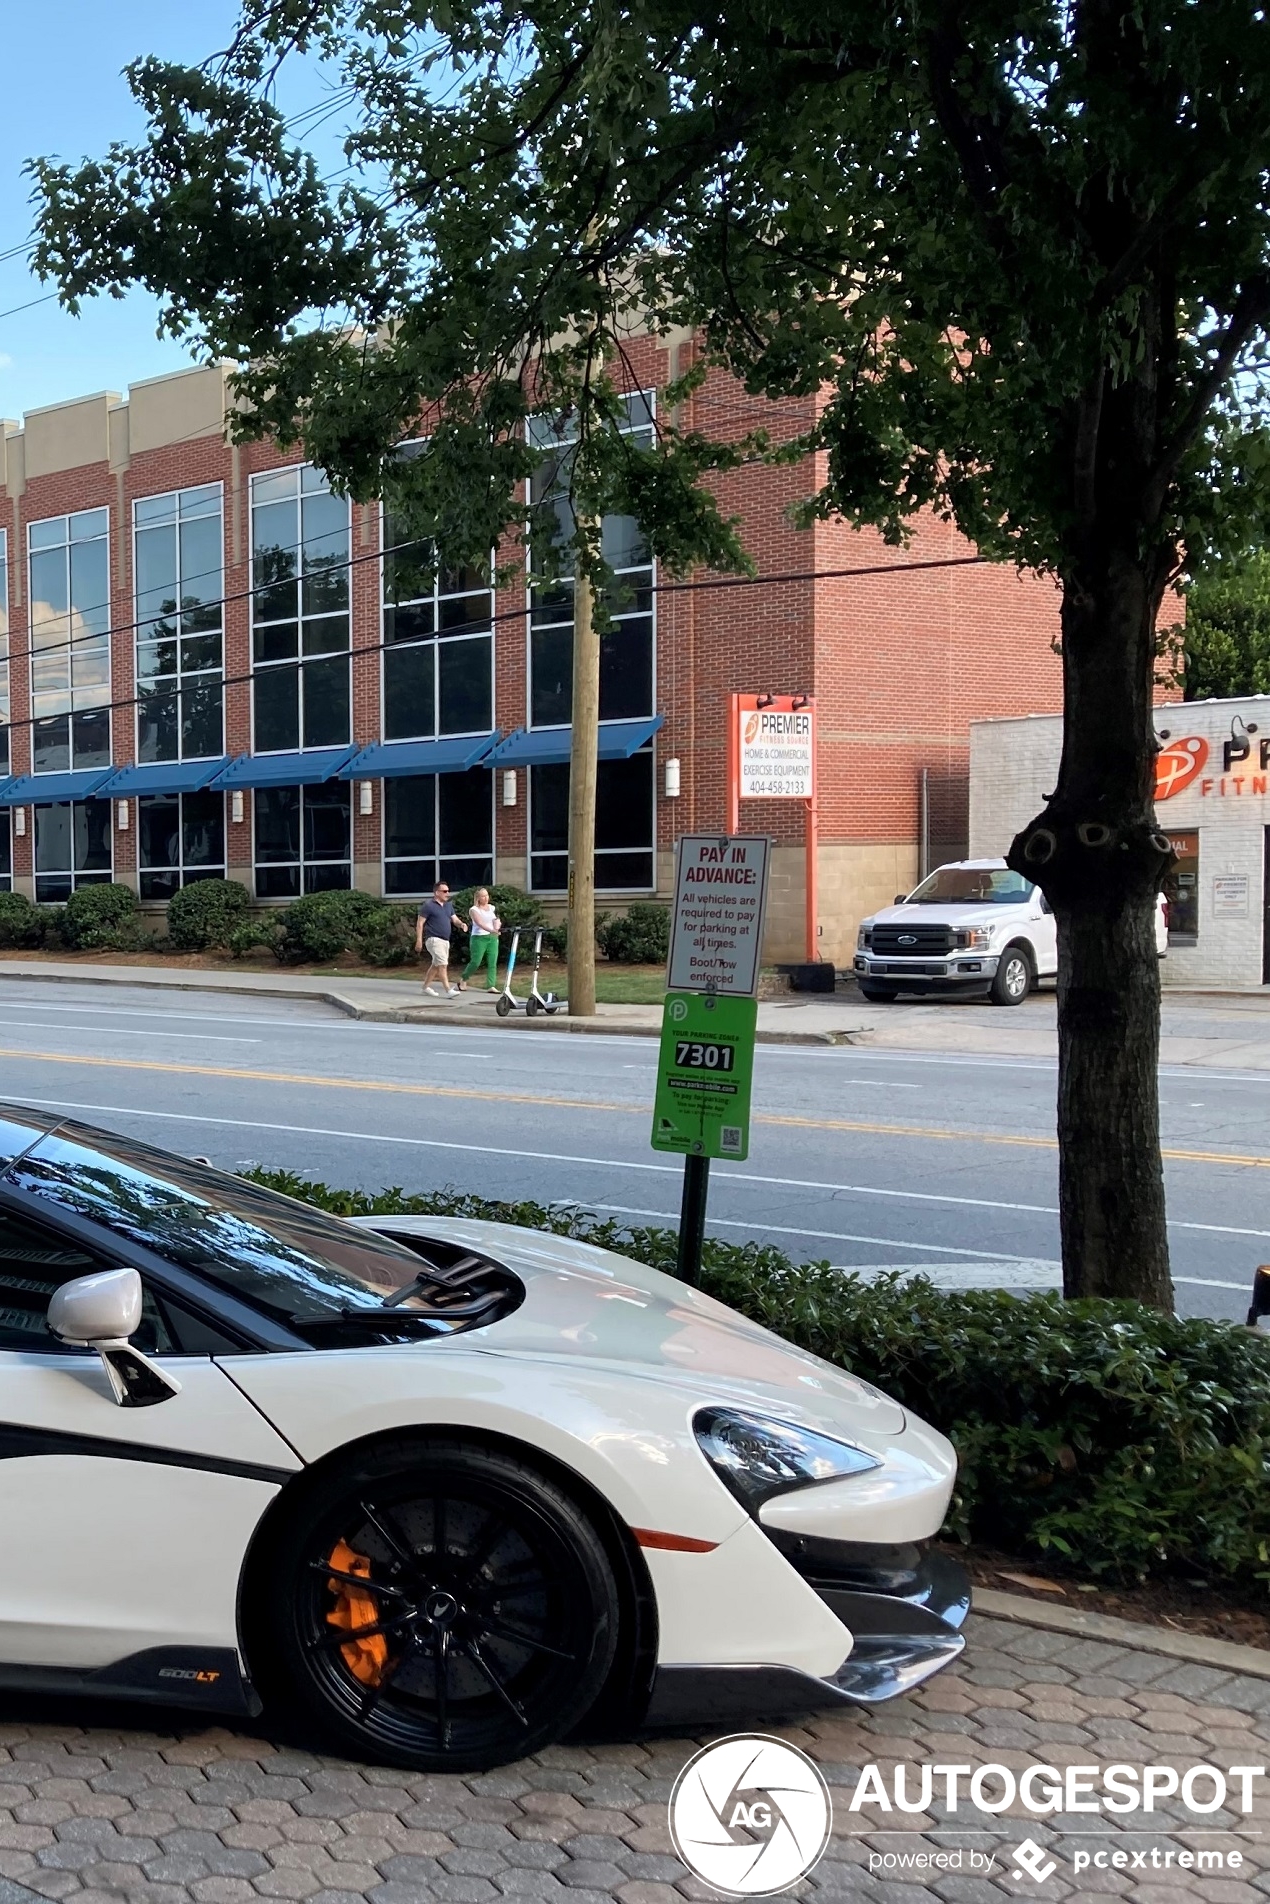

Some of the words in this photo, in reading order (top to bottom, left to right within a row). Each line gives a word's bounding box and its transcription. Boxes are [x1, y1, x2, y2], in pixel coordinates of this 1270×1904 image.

[761, 714, 809, 735] PREMIER
[760, 735, 785, 745] FITNESS
[787, 736, 809, 745] SOURCE
[744, 748, 764, 759] HOME
[765, 749, 770, 759] &
[770, 749, 809, 760] COMMERCIAL
[744, 764, 773, 776] EXERCISE
[774, 765, 810, 777] EQUIPMENT
[750, 780, 805, 794] 404-458-2133
[1201, 776, 1267, 797] FITN
[699, 847, 728, 863] PAY
[732, 847, 747, 863] IN
[685, 867, 757, 884] ADVANCE:
[682, 893, 695, 903] All
[697, 894, 737, 905] vehicles
[740, 897, 756, 906] are
[681, 909, 722, 919] required
[725, 910, 734, 919] to
[737, 912, 755, 922] pay
[684, 922, 697, 931] for
[700, 923, 737, 936] parking
[739, 926, 749, 935] at
[693, 937, 705, 946] all
[707, 938, 737, 949] times.
[690, 957, 737, 969] Boot/Tow
[690, 972, 734, 984] enforced
[690, 1031, 717, 1040] PARKING
[677, 1043, 731, 1069] 7301
[158, 1668, 220, 1682] 600LT
